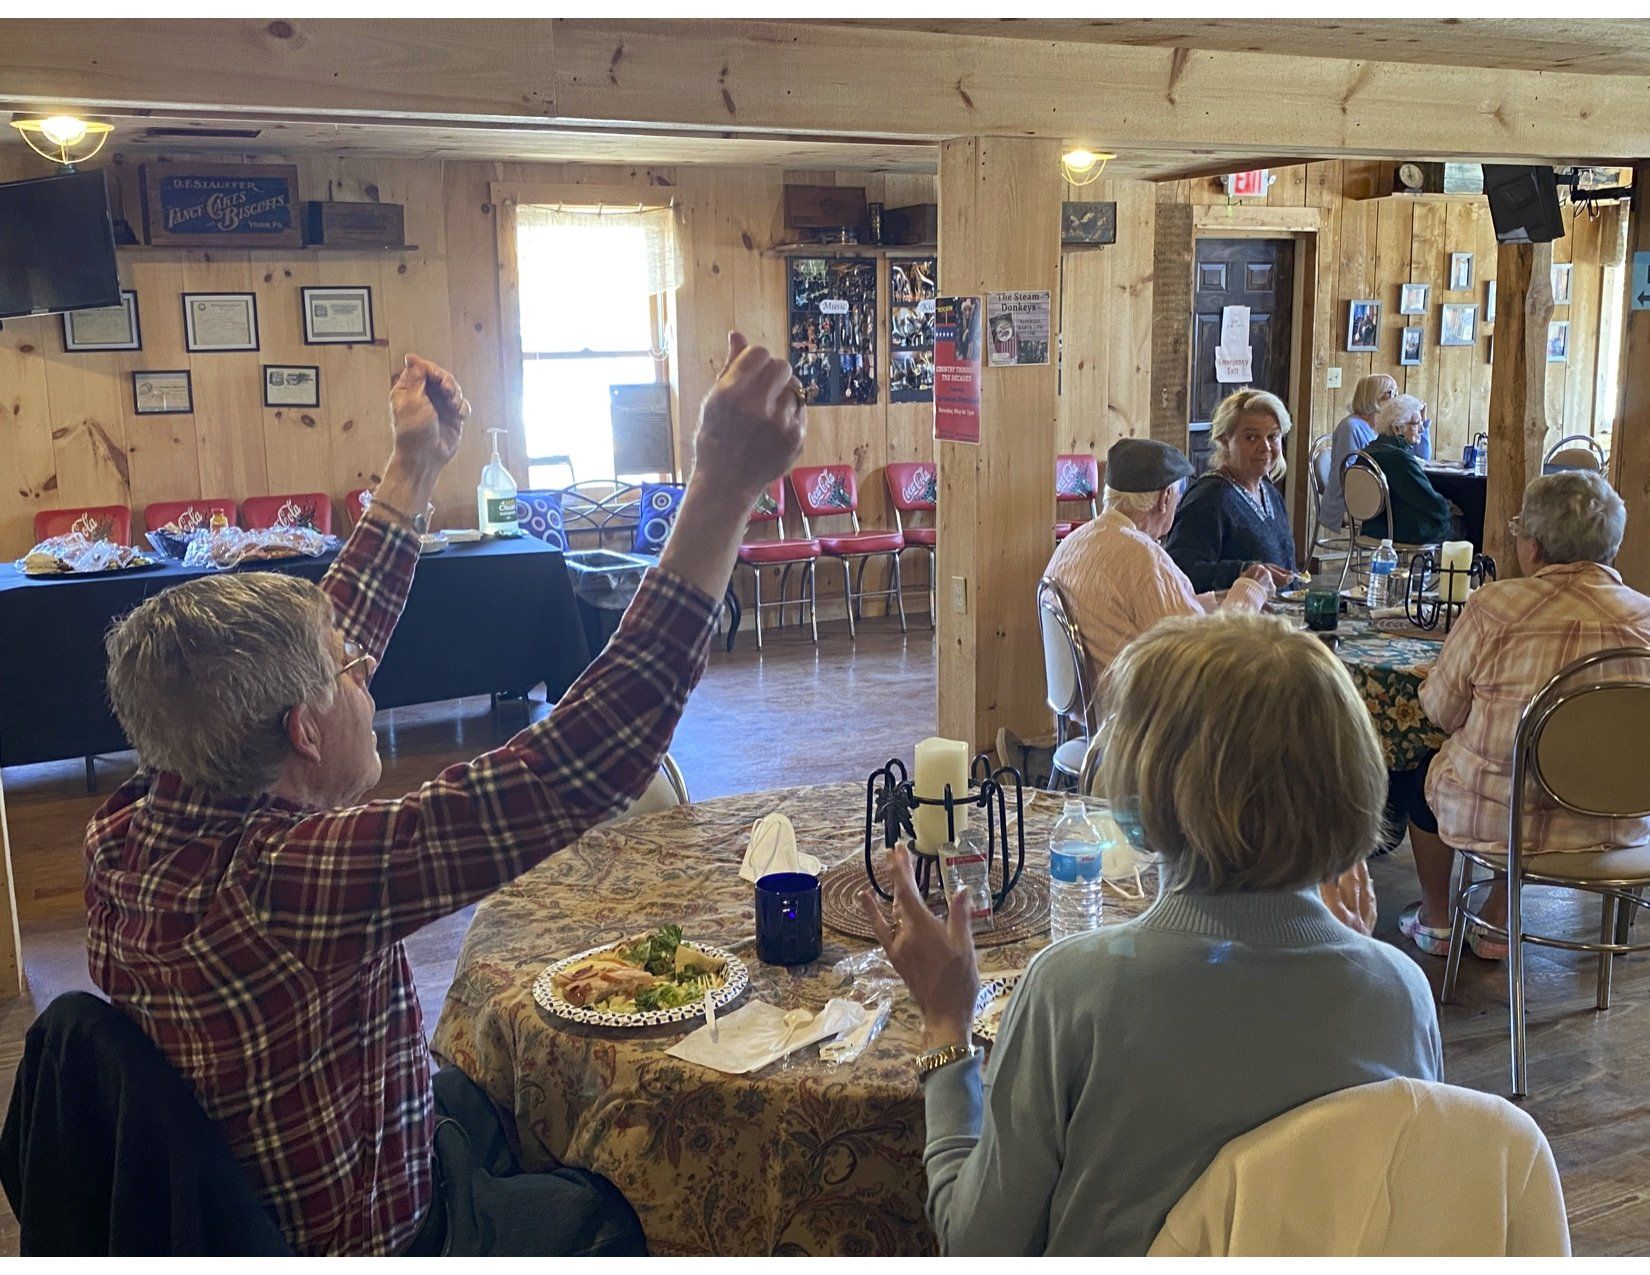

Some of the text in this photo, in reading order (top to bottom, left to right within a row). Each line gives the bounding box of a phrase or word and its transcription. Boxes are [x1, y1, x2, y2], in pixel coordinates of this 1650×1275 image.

[168, 191, 246, 228] FANCY CAKES
[218, 195, 285, 231] BISCUITS
[997, 292, 1040, 301] The Steam
[823, 302, 846, 310] Music
[1001, 303, 1036, 314] Donkeys
[951, 374, 971, 382] DECADES
